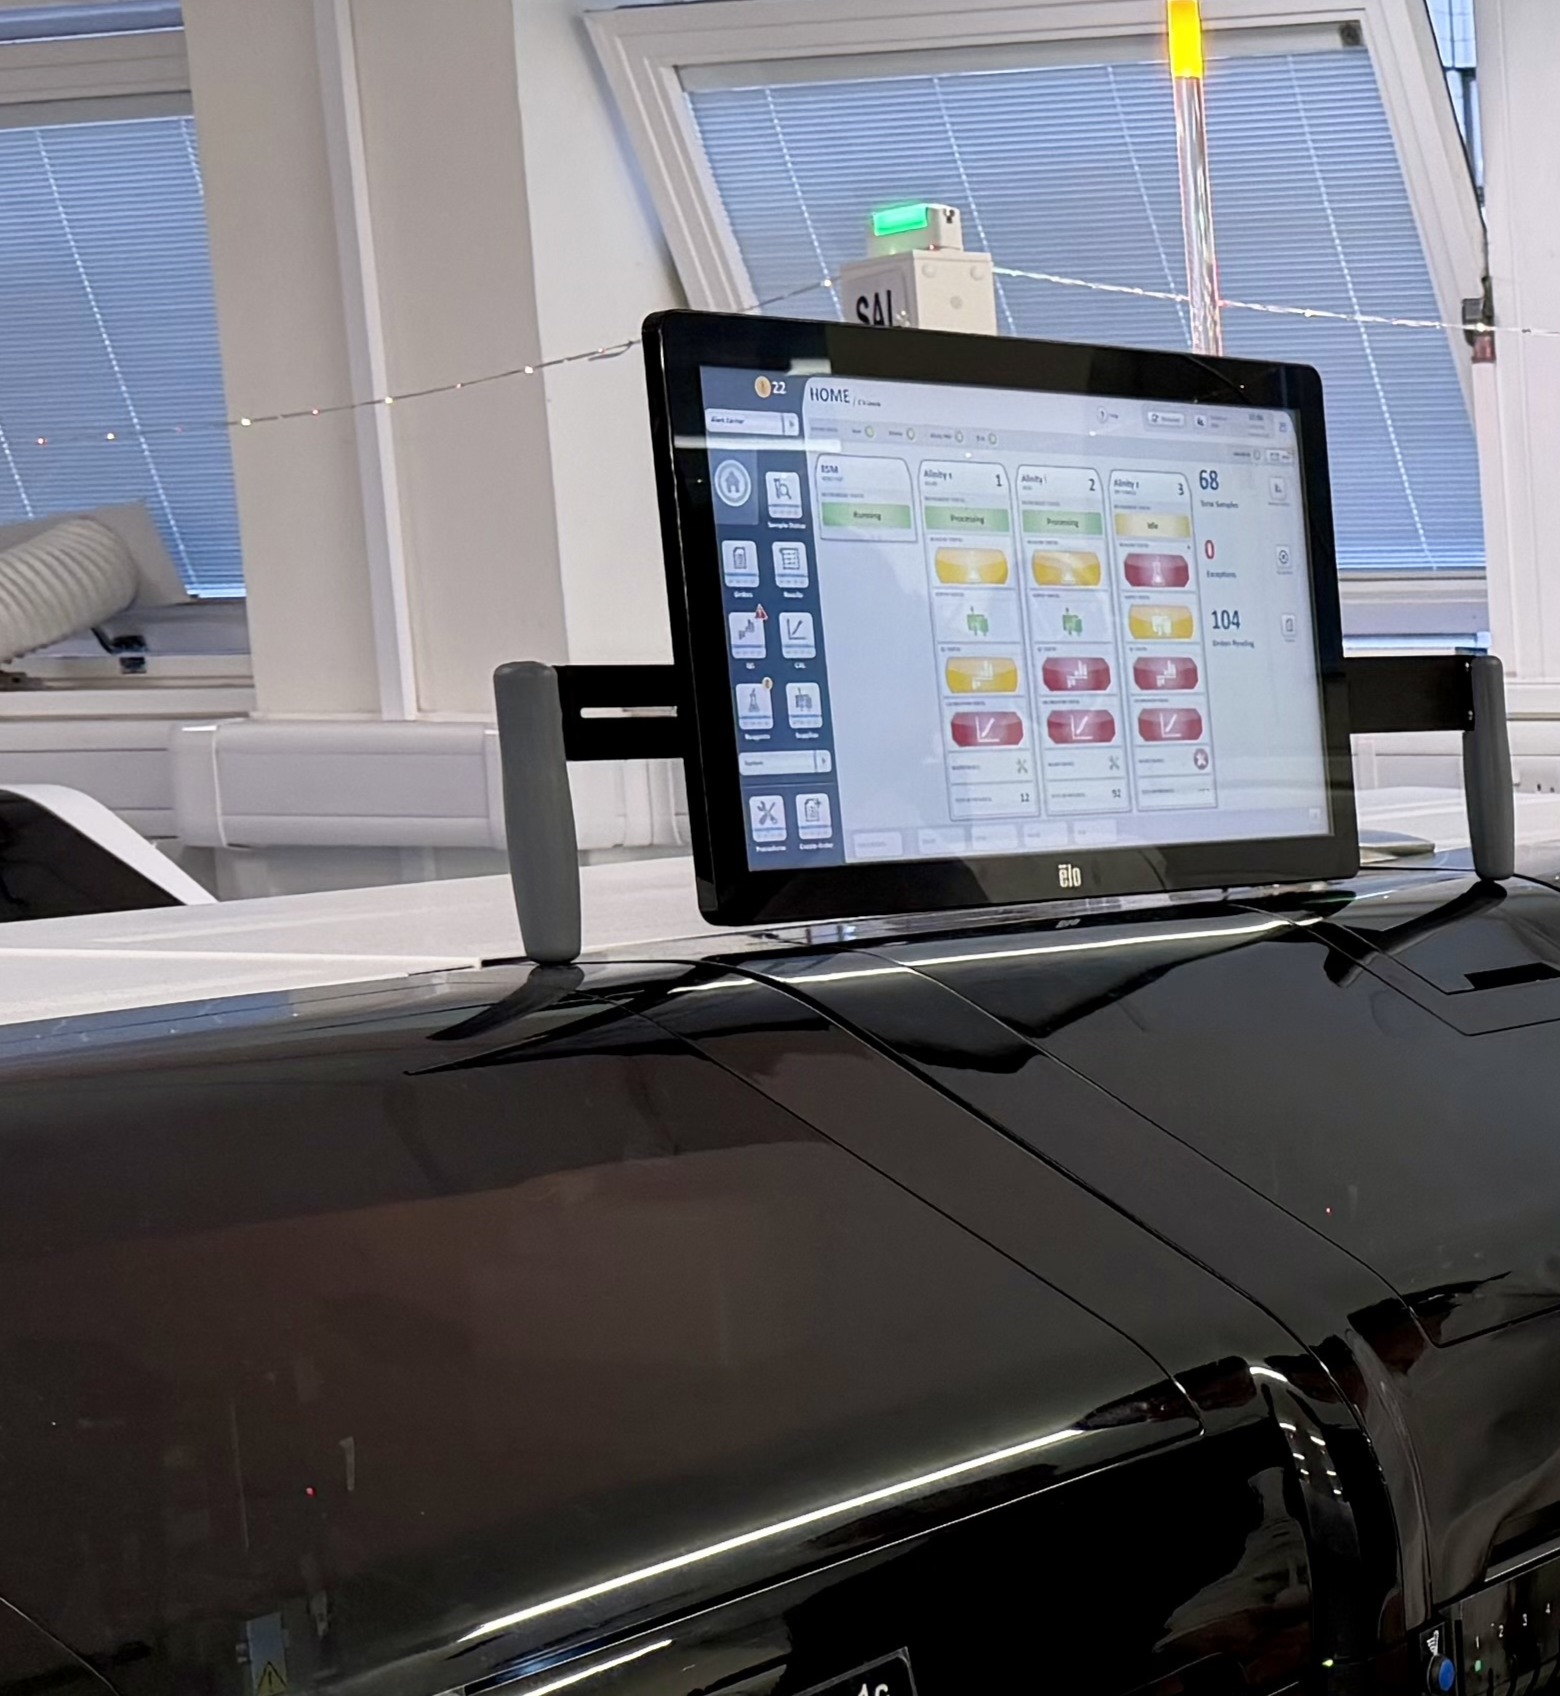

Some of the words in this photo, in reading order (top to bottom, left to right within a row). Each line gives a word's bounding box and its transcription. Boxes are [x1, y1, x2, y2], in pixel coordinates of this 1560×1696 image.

[772, 381, 787, 394] 22
[809, 387, 850, 403] HOME
[995, 474, 1002, 487] 1
[1089, 479, 1096, 491] 2
[1199, 469, 1219, 491] 68
[1178, 483, 1184, 495] 3
[1211, 610, 1241, 630] 104
